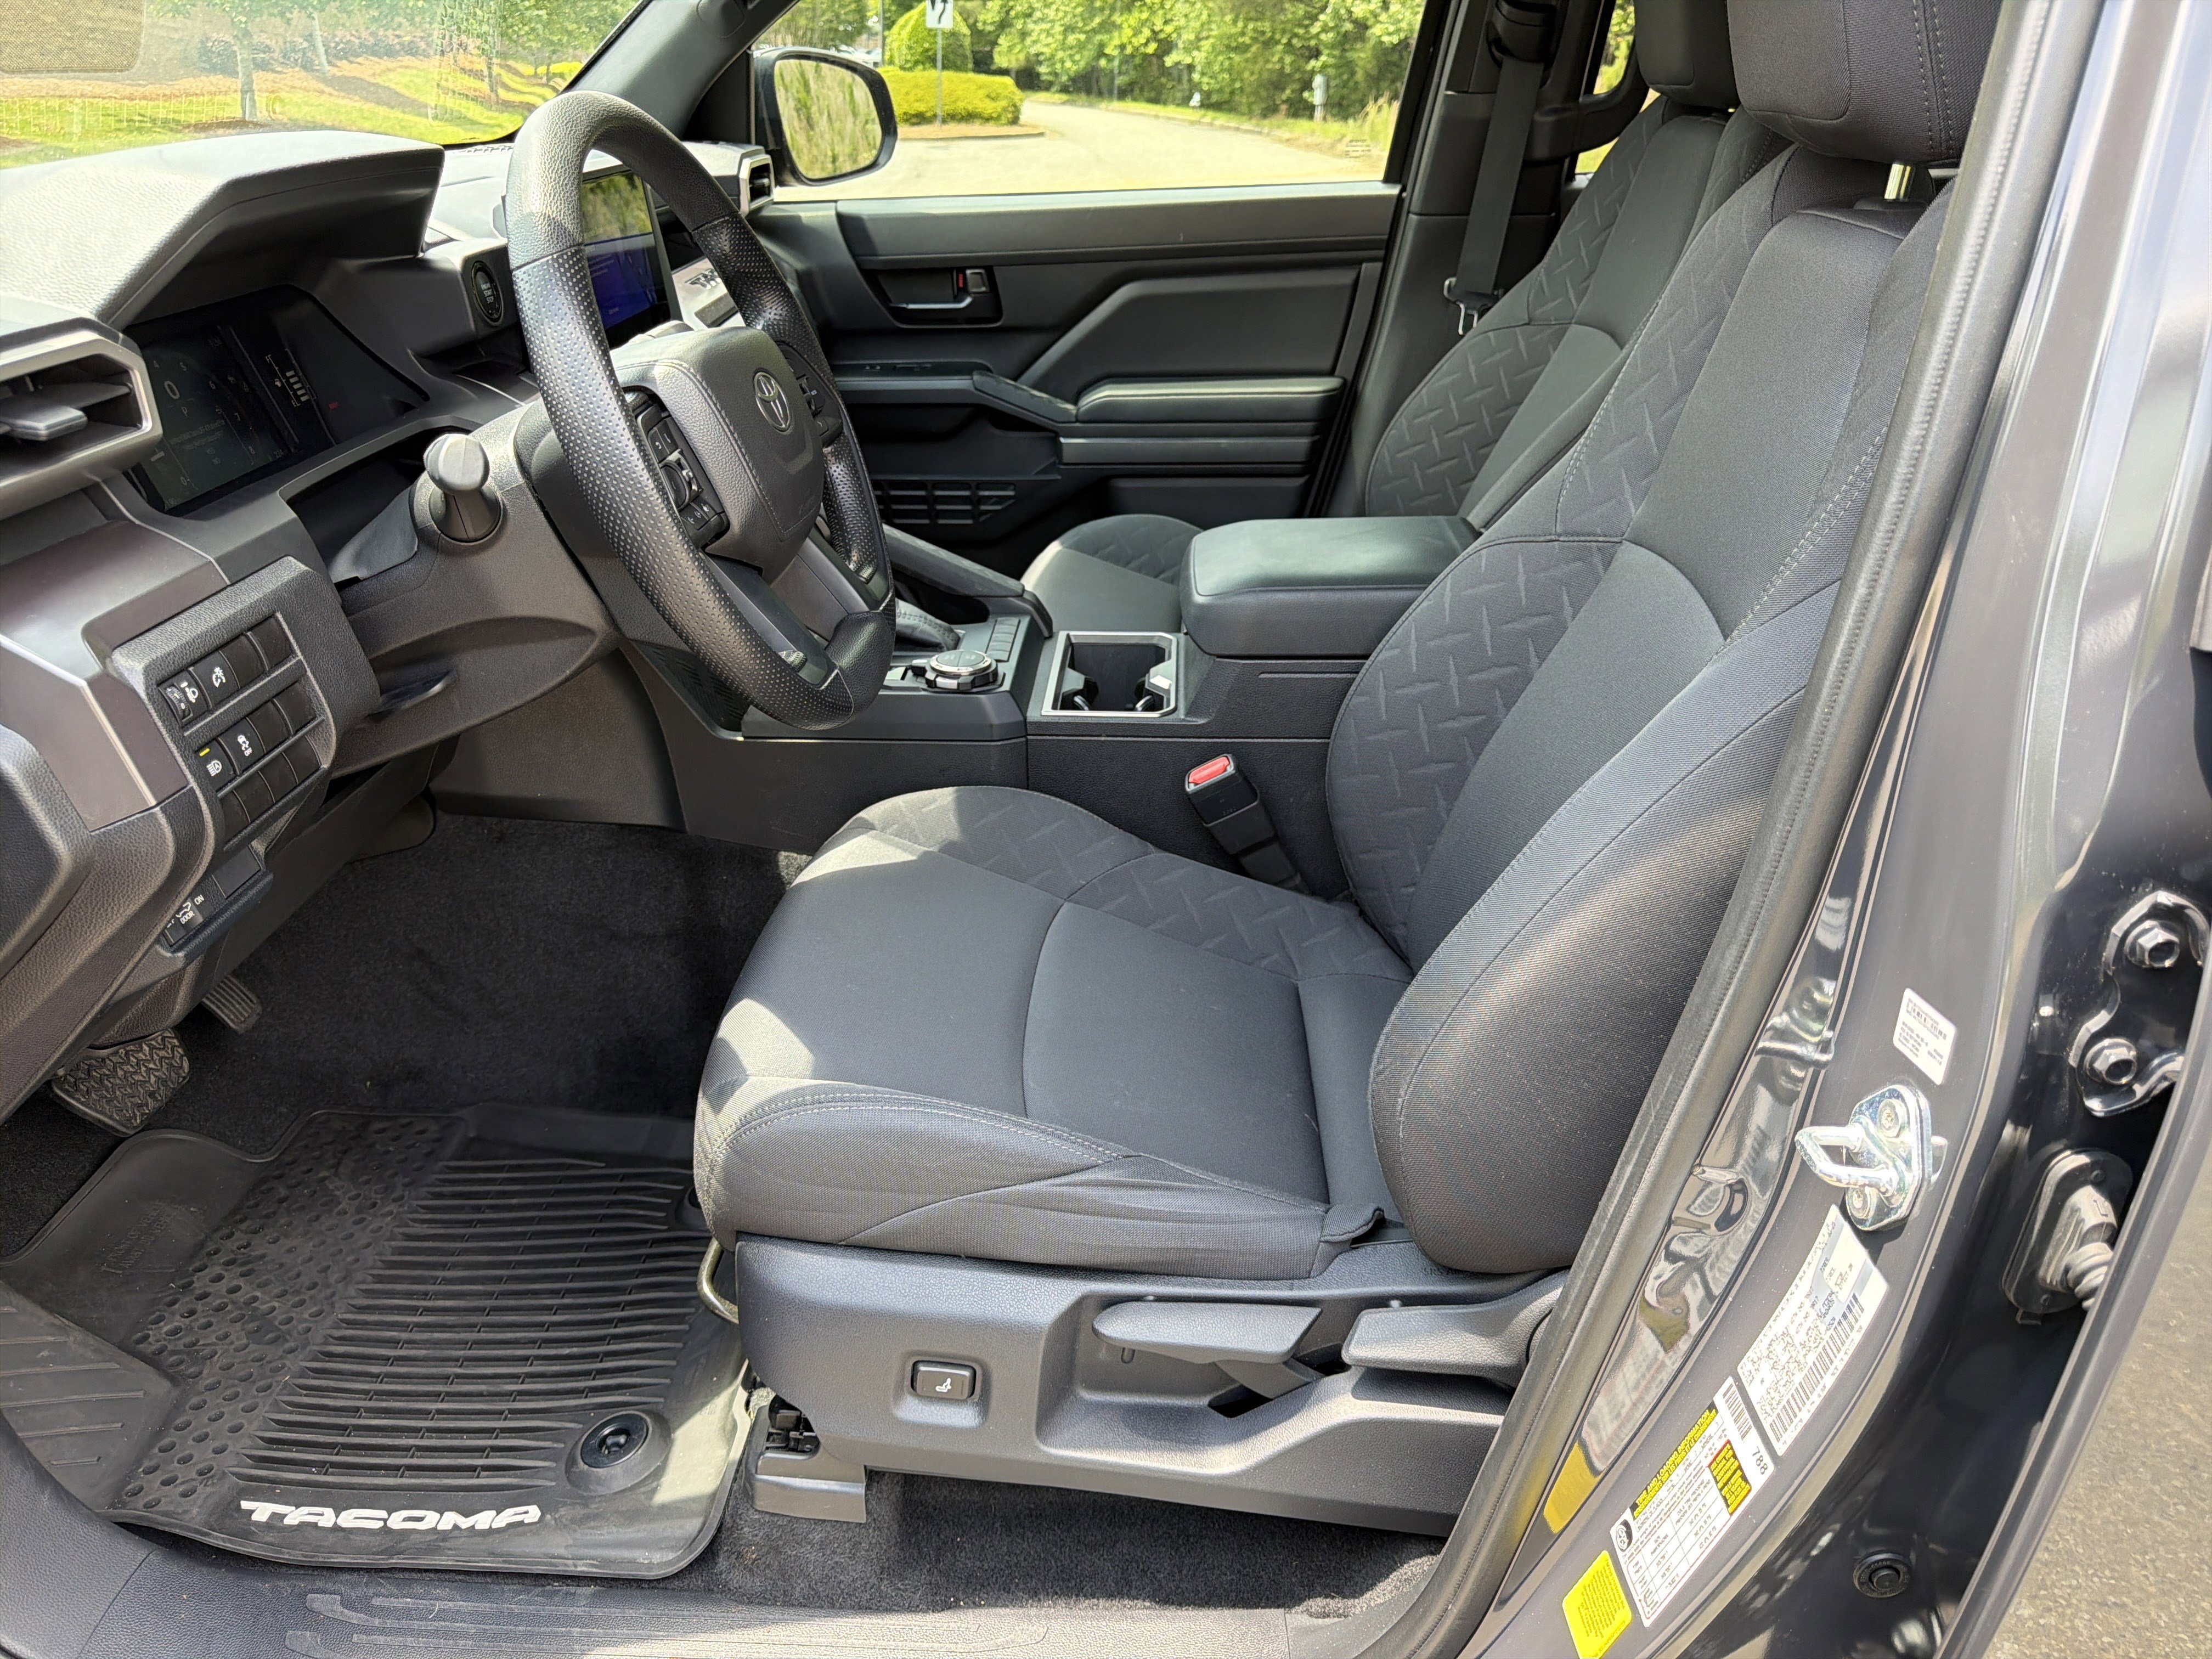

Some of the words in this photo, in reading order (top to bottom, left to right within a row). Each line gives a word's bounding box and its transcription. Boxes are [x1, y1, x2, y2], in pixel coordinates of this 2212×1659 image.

[164, 380, 180, 399] 0
[208, 381, 216, 390] 6
[181, 407, 188, 417] P
[194, 894, 205, 905] ON
[179, 911, 195, 924] DOOR
[1635, 1489, 1647, 1507] TIRE
[1646, 1475, 1658, 1493] AND
[1656, 1449, 1678, 1480] LOADING
[1677, 1409, 1710, 1454] INFORMATION
[1752, 1446, 1768, 1475] 788
[240, 1499, 541, 1531] TACOMA
